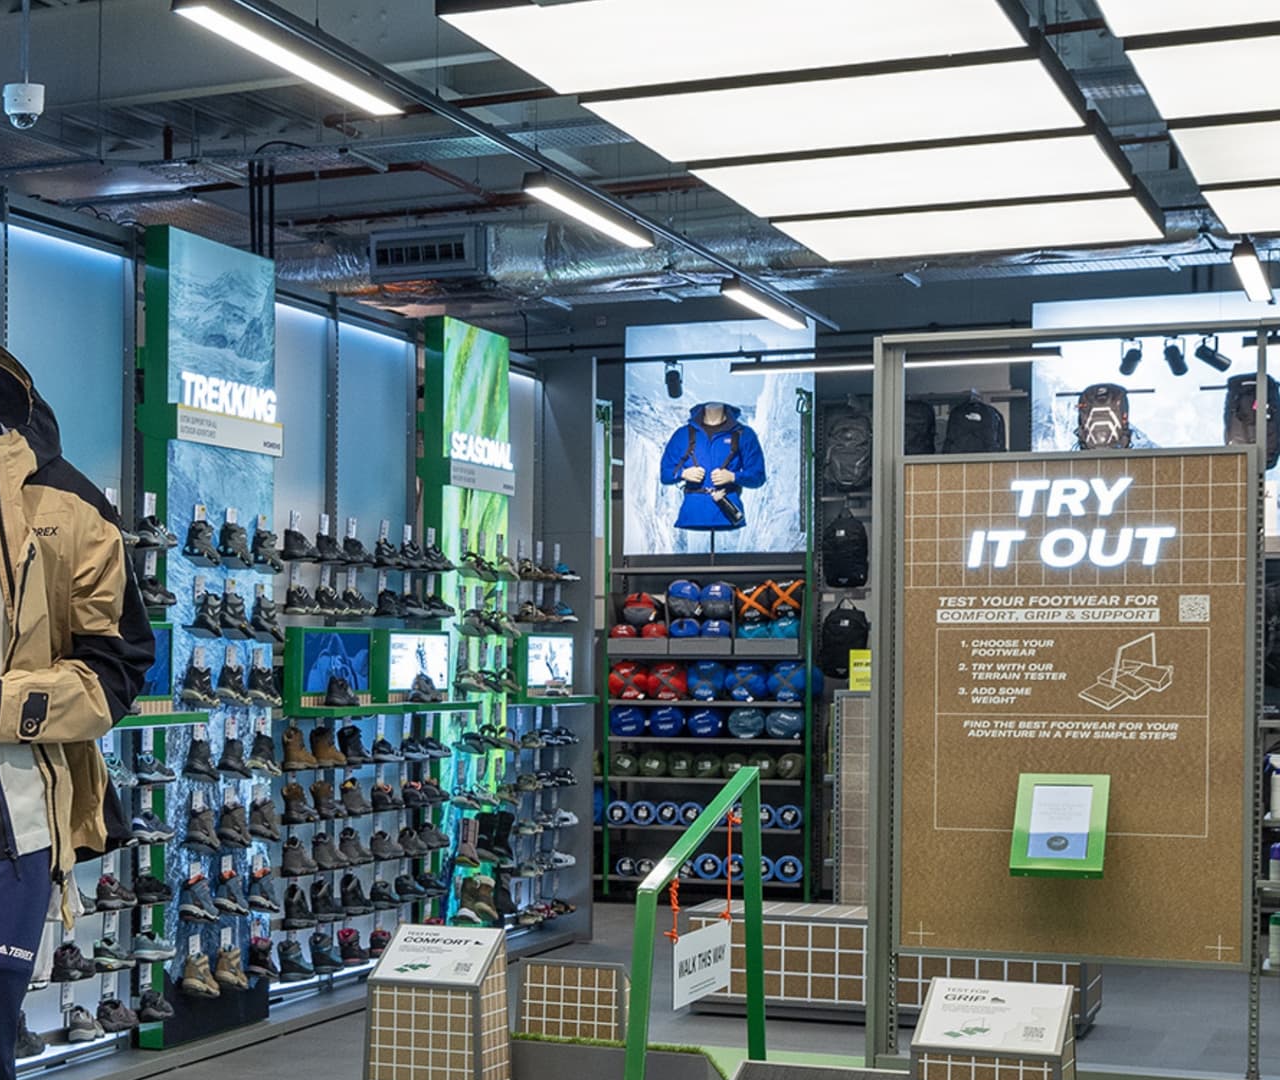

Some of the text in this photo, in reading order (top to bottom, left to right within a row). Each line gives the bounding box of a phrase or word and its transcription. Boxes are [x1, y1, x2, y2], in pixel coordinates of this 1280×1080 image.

[181, 370, 278, 423] TREKKING
[450, 431, 514, 470] SEASONAL
[1010, 476, 1133, 518] TRY
[967, 526, 1176, 568] IT OUT
[938, 595, 1158, 608] TEST YOUR FOOTWEAR FOR
[940, 609, 1157, 622] COMFORT, GRIP & SUPPORT
[961, 639, 1055, 648] 1. CHOOSE YOUR
[971, 648, 1037, 657] FOOTWEAR
[958, 663, 1054, 671] 2. TRY WITH OUR
[971, 672, 1067, 680] TERRAIN TESTER
[958, 687, 1032, 695] 3. ADD SOME
[971, 696, 1017, 704] WEIGHT
[963, 720, 1179, 731] FIND THE BEST FOOTWEAR FOR YOUR
[968, 729, 1178, 740] ADVENTURE IN A FEW SIMPLE STEPS
[403, 936, 470, 946] COMFORT
[698, 949, 712, 970] THIS
[713, 944, 727, 964] WAY
[944, 993, 986, 1002] GRIP
